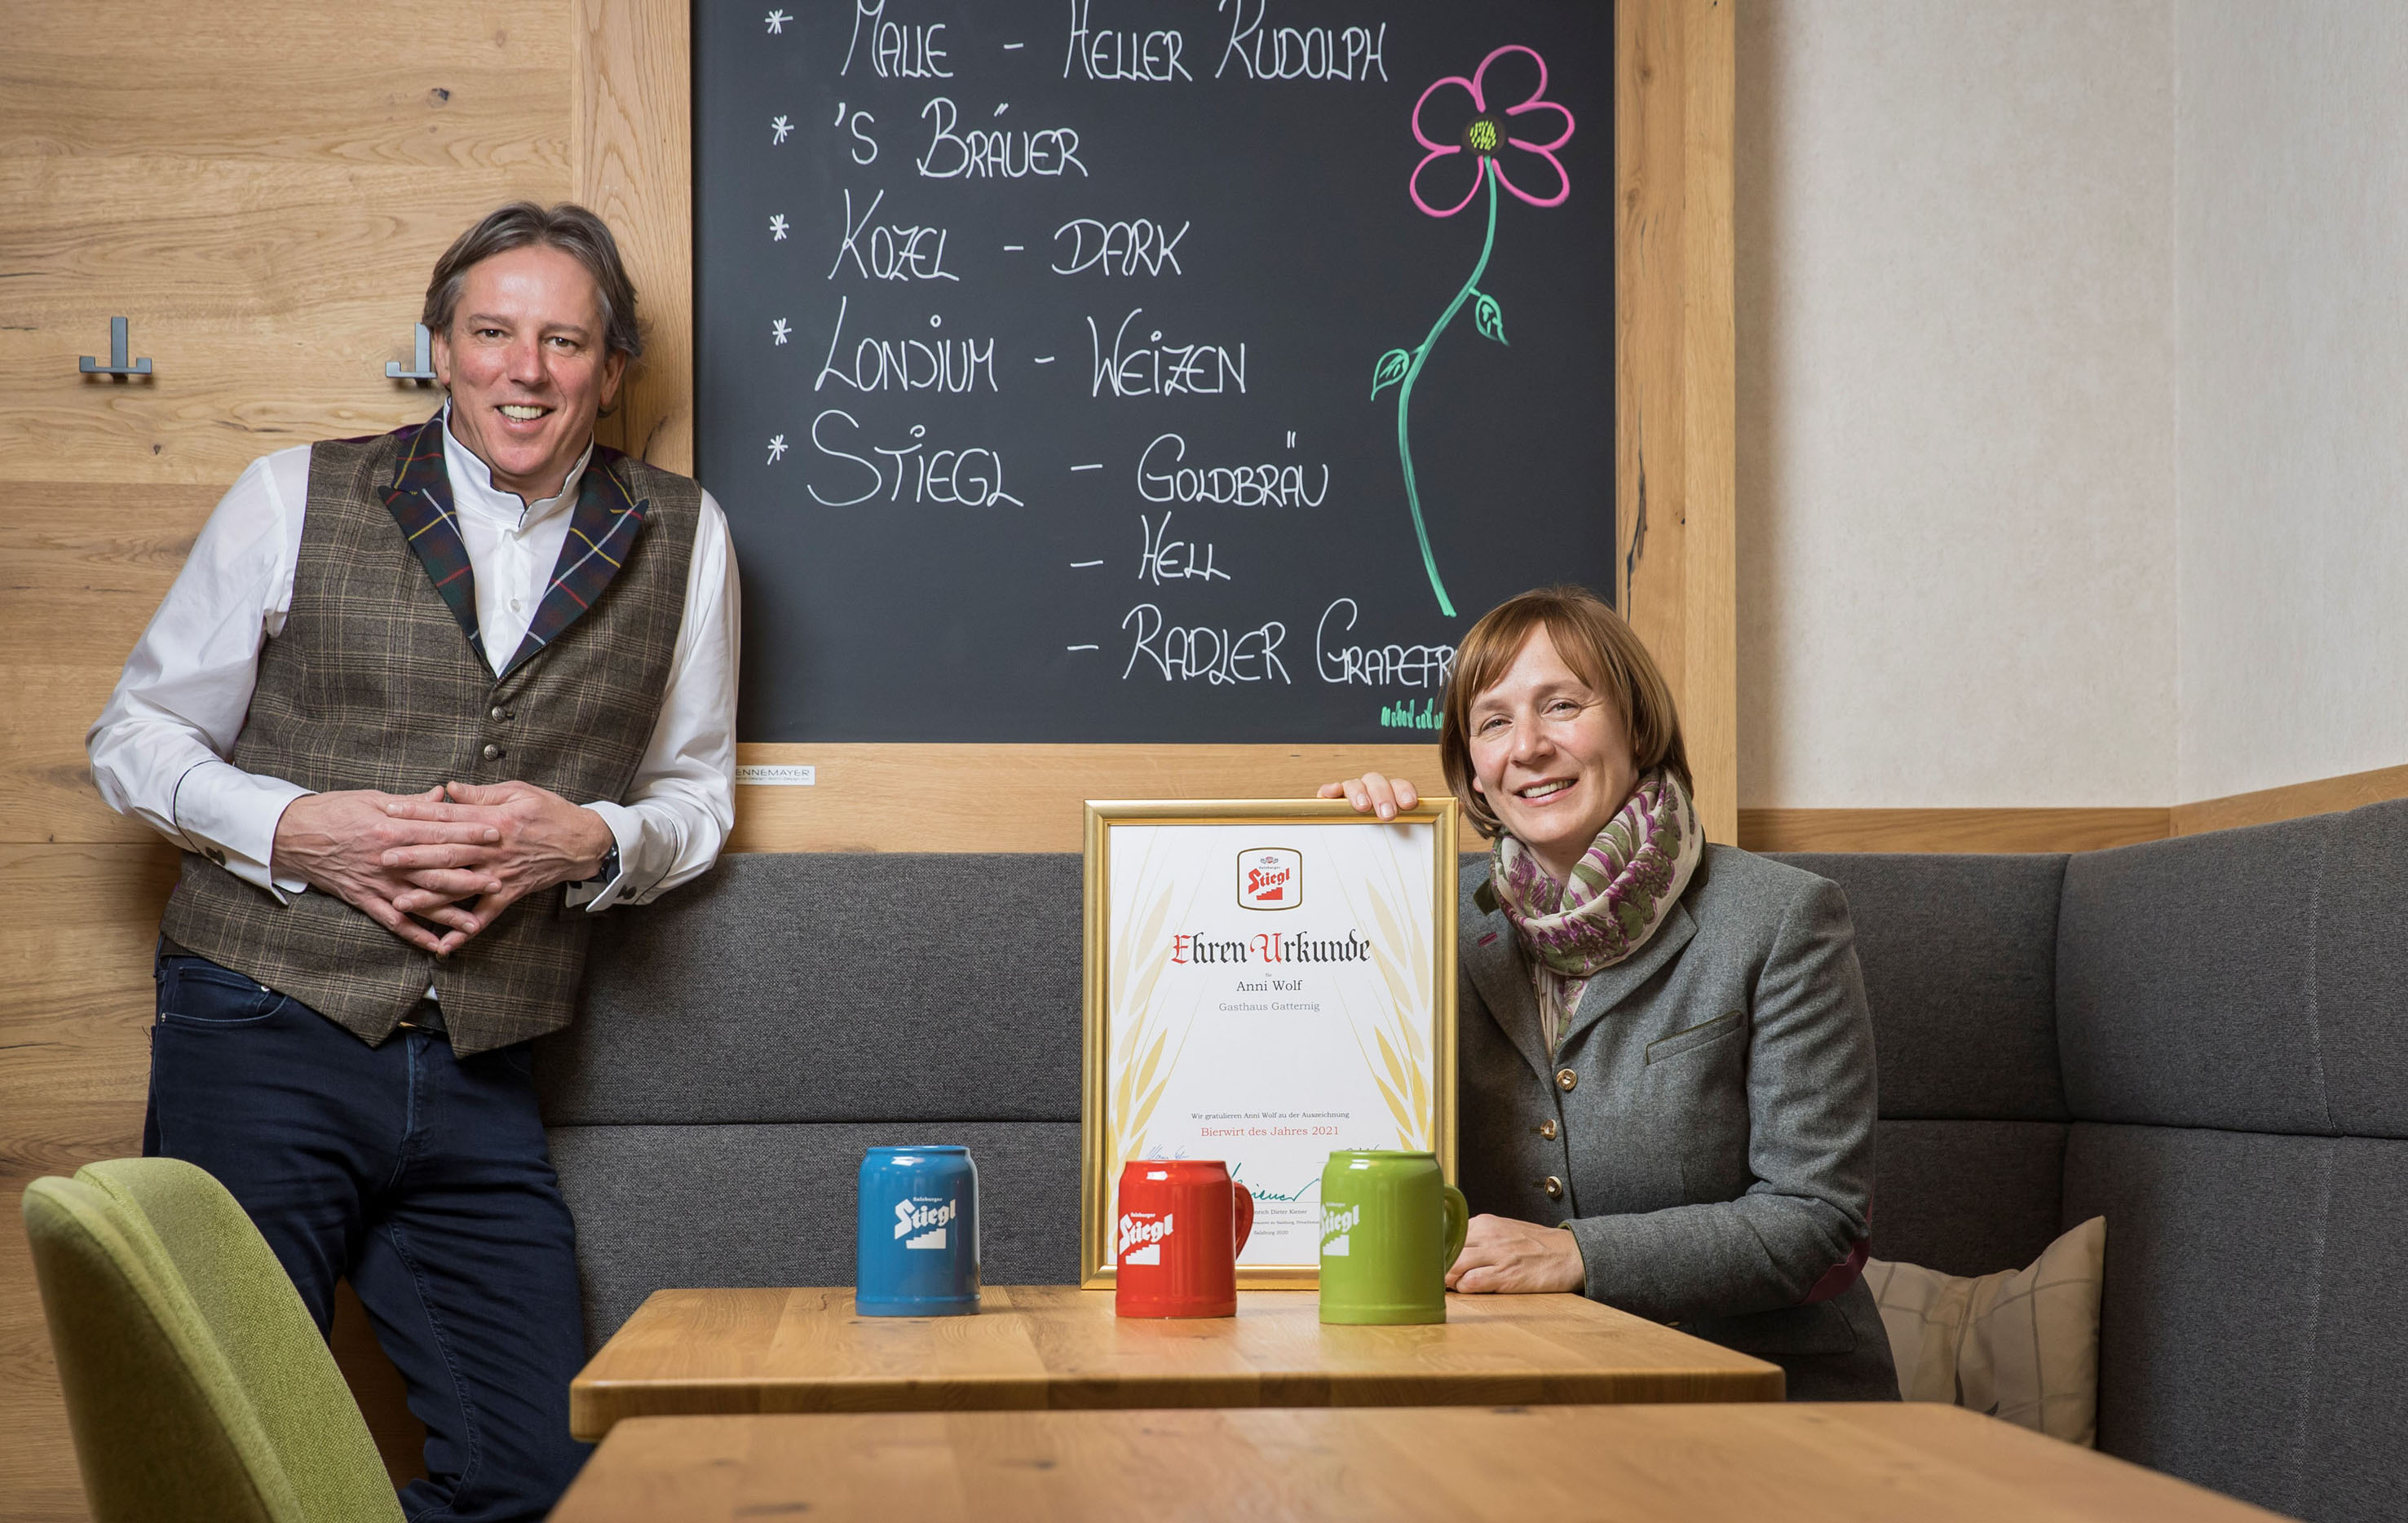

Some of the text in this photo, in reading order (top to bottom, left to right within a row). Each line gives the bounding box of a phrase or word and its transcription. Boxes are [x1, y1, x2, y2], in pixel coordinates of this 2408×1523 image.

[1063, 0, 1192, 82] HELLER
[1215, 0, 1388, 82] RUDOLPH
[828, 189, 959, 280] KOZEL
[1052, 219, 1189, 276] DARK
[1138, 511, 1231, 585] HELL
[1122, 604, 1291, 685] RADLER
[1315, 597, 1459, 688] GRAPEFR
[1248, 867, 1290, 894] Stiegl
[1171, 929, 1370, 966] Ehren Urkunde
[1237, 980, 1302, 991] Anni Wolf
[1219, 1002, 1319, 1012] Gasthaus Gatternig
[1201, 1126, 1339, 1137] Bierwirt des Jahres 2021
[894, 1199, 957, 1239] Stiegl
[1119, 1213, 1174, 1255] Stiegl
